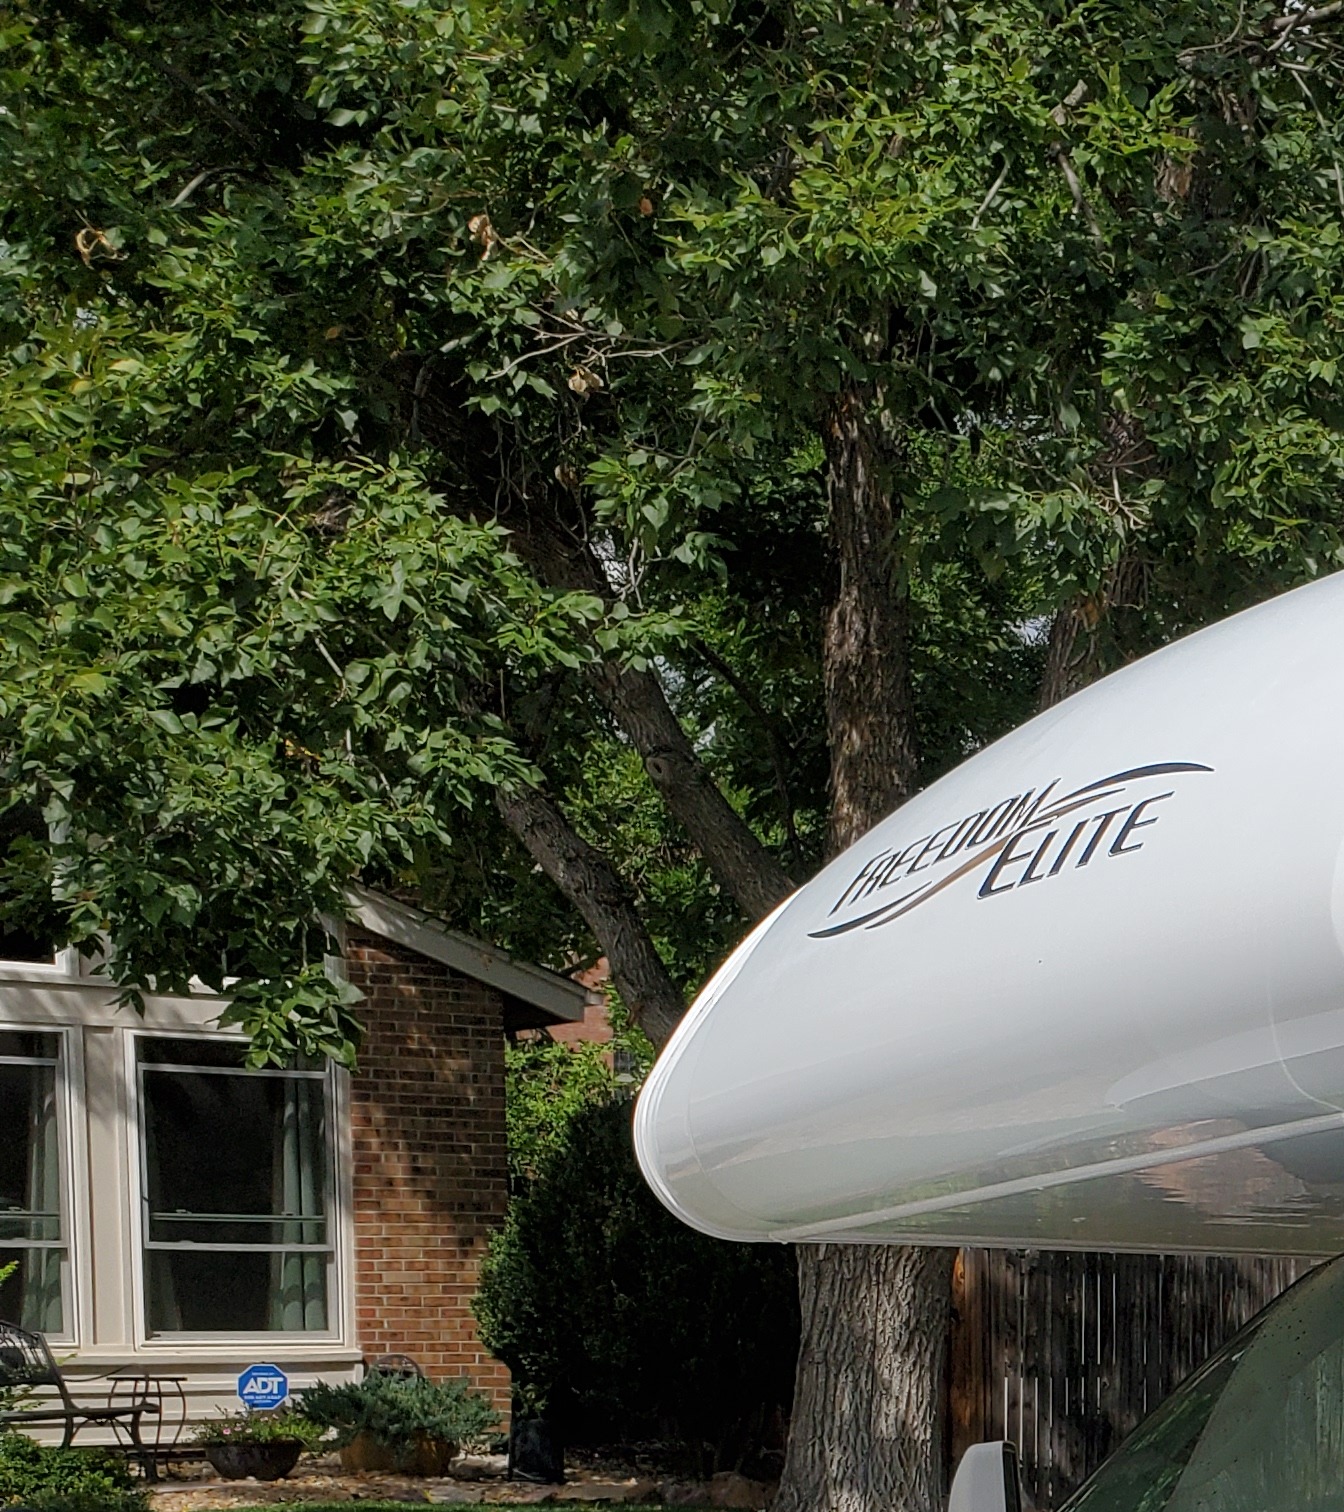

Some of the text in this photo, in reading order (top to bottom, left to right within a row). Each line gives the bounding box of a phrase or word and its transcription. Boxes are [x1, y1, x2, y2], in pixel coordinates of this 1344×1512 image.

[827, 776, 1061, 918] FREEDOM
[976, 789, 1176, 900] ELITE
[242, 1376, 284, 1395] ADT
